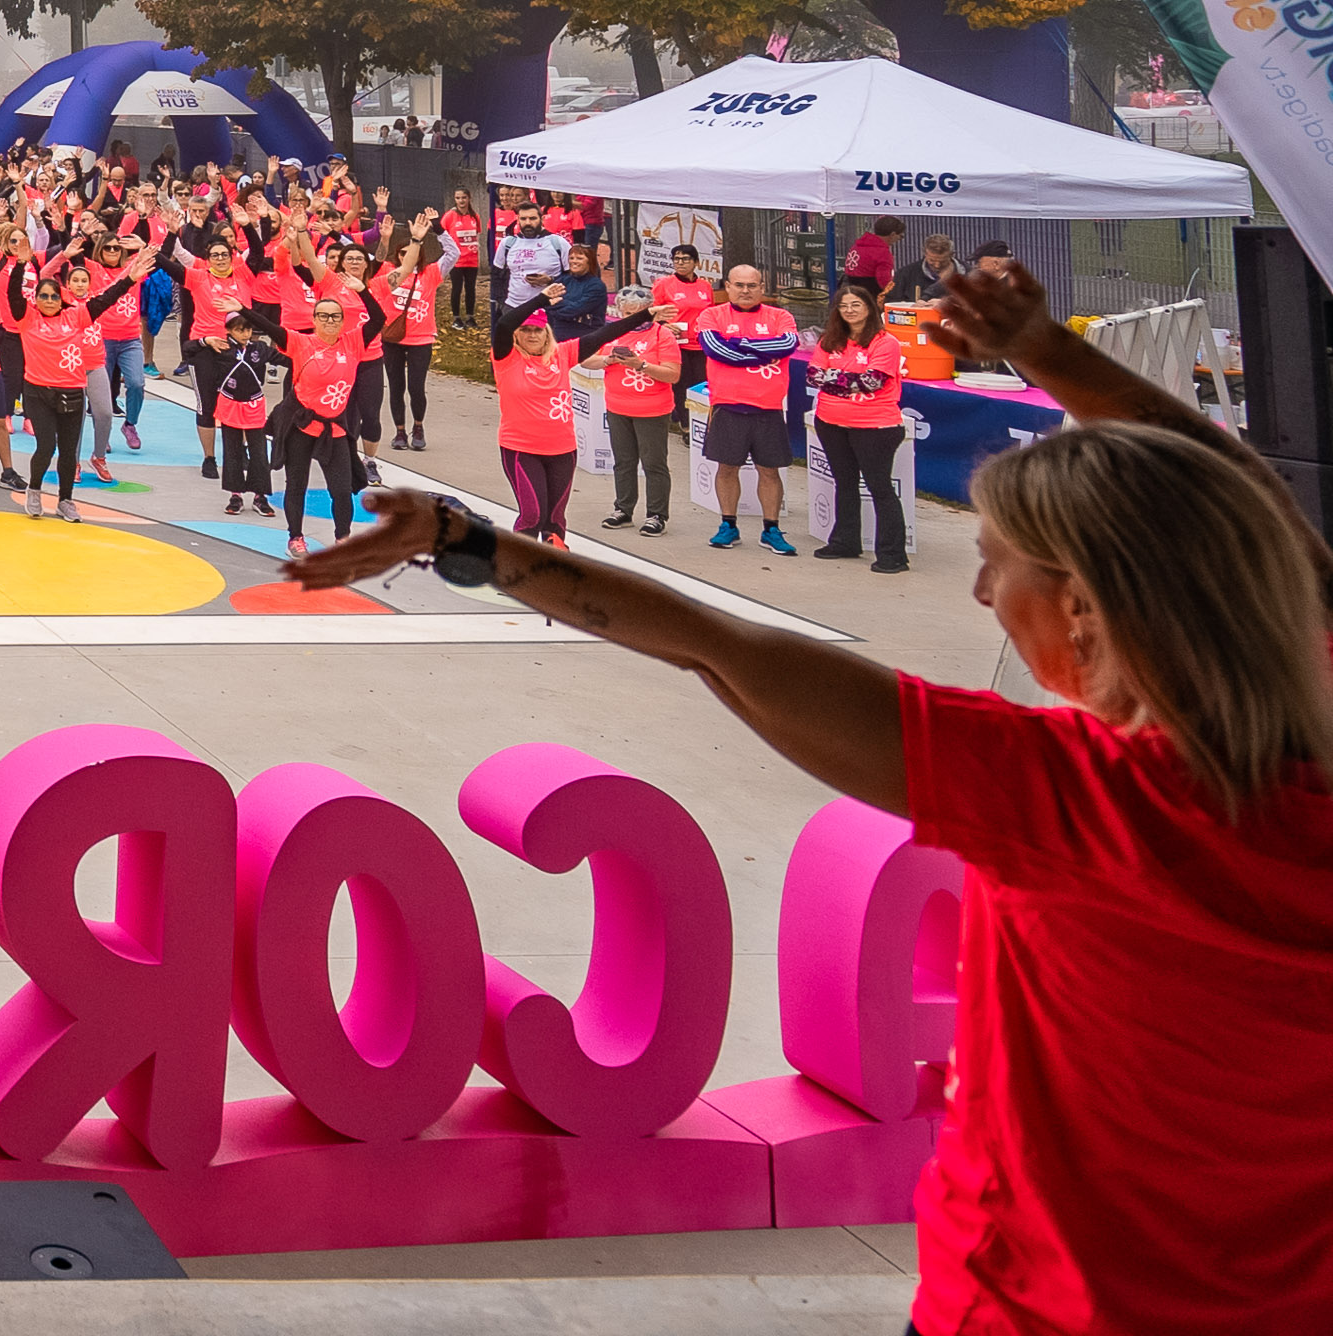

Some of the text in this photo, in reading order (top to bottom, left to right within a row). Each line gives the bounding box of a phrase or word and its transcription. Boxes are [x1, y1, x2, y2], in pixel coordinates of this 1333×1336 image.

[158, 97, 200, 108] HUB
[689, 92, 818, 116] ZUEGG
[499, 150, 548, 171] ZUEGG
[855, 171, 961, 193] ZUEGG
[873, 198, 944, 208] DAL 1890
